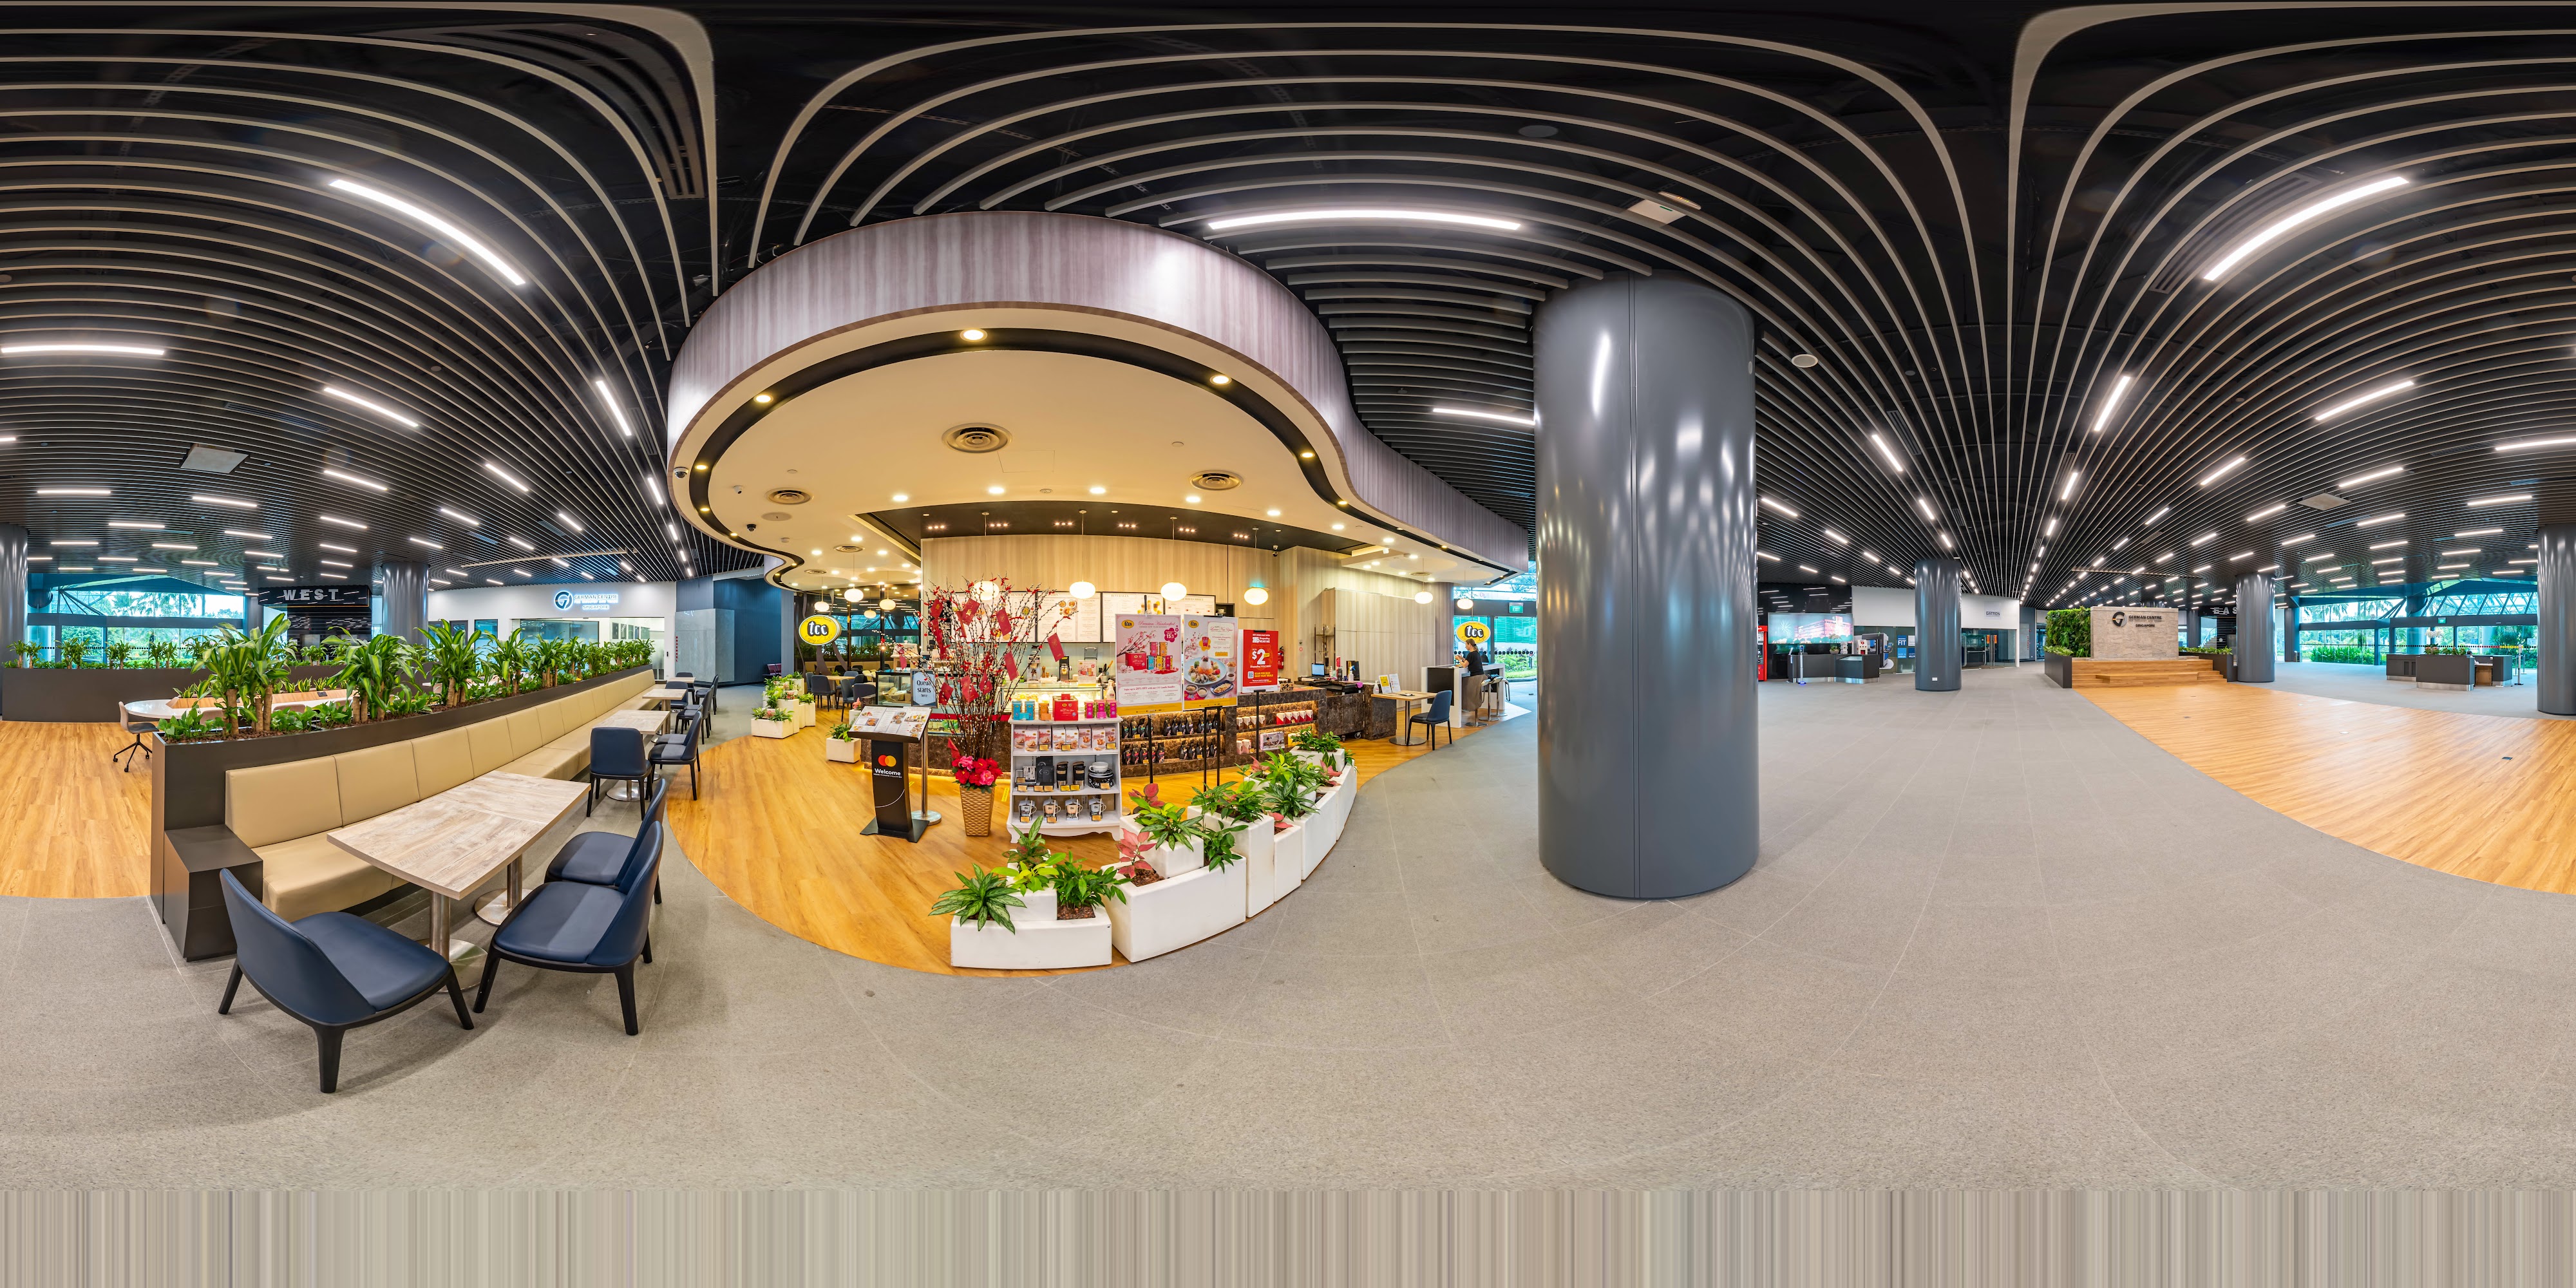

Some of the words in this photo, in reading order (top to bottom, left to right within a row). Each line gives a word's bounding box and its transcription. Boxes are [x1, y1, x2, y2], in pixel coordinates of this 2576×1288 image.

[283, 589, 339, 601] WEST
[808, 621, 828, 636] tcc
[1465, 625, 1484, 638] tcc
[1252, 649, 1265, 665] $2
